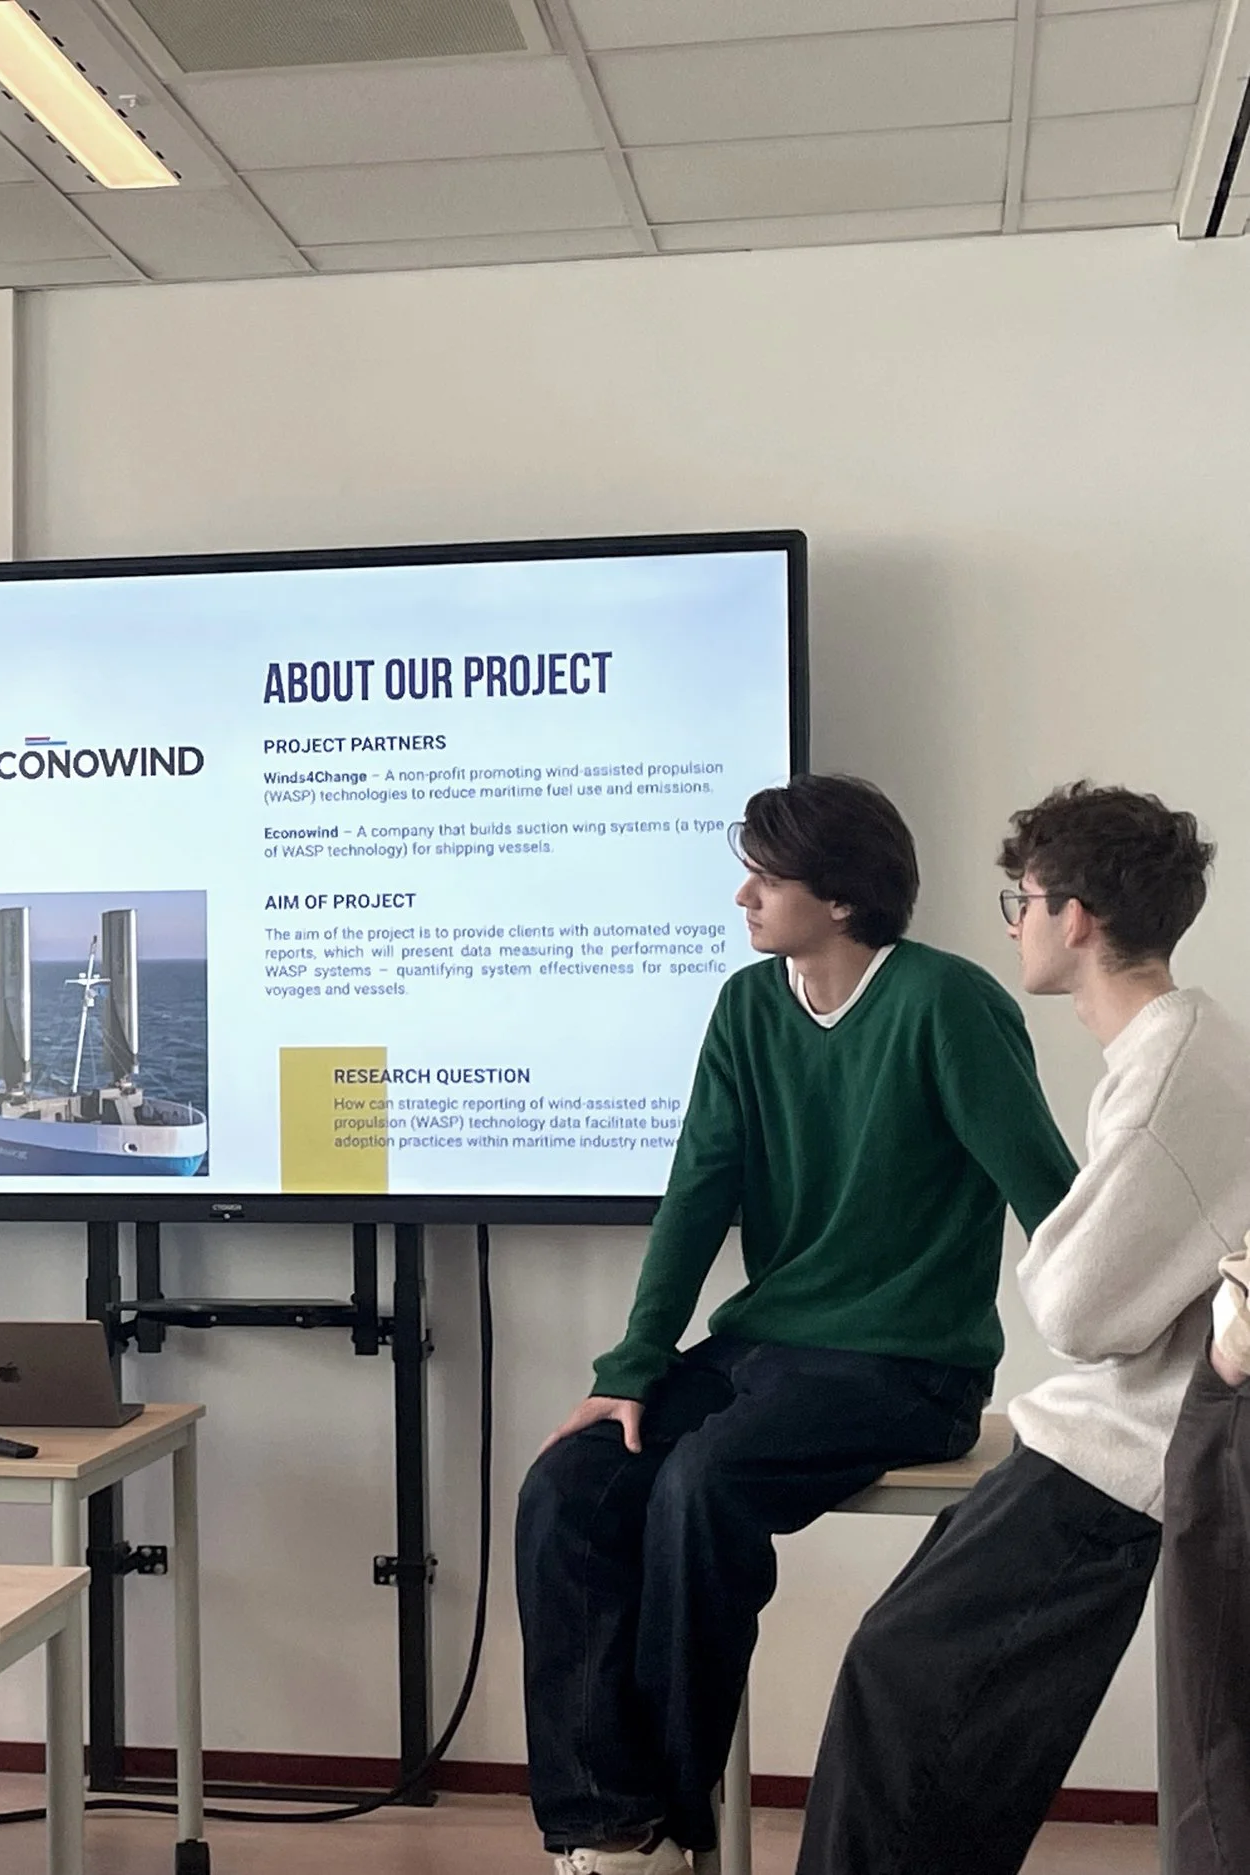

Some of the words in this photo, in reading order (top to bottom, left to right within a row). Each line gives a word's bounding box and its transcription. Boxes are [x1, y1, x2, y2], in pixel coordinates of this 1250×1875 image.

[263, 660, 374, 703] ABOUT
[384, 657, 452, 701] OUR
[463, 651, 614, 697] PROJECT
[264, 737, 346, 754] PROJECT
[351, 735, 447, 752] PARTNERS
[263, 769, 368, 786] Winds4Change
[384, 768, 396, 781] A
[398, 766, 466, 783] non-profit
[469, 764, 542, 781] promoting
[545, 762, 644, 777] wind-assisted
[647, 760, 724, 777] propulsion
[264, 787, 316, 804] (WASP)
[319, 786, 408, 803] technologies
[411, 786, 426, 798] to
[428, 785, 476, 798] reduce
[479, 783, 543, 797] maritime
[546, 783, 573, 796] fuel
[576, 785, 602, 795] use
[606, 781, 633, 795] and
[636, 780, 714, 794] emissions.
[264, 825, 339, 839] Econowind
[356, 824, 368, 837] A
[370, 826, 435, 839] company
[438, 822, 466, 835] that
[516, 820, 569, 834] suction
[572, 819, 607, 835] wing
[609, 818, 671, 835] systems
[675, 817, 689, 833] (a
[693, 817, 725, 833] type
[264, 844, 279, 857] of
[282, 844, 324, 857] WASP
[327, 841, 408, 859] technology)
[411, 842, 432, 855] for
[435, 841, 495, 857] shipping
[498, 840, 555, 853] vessels.
[265, 895, 300, 910] AIM
[305, 894, 328, 909] OF
[333, 893, 416, 909] PROJECT
[264, 927, 291, 940] The
[294, 927, 320, 940] aim
[323, 927, 339, 939] of
[341, 926, 364, 939] the
[367, 926, 416, 941] project
[419, 925, 431, 938] is
[434, 925, 449, 938] to
[452, 925, 505, 940] provide
[508, 924, 555, 937] clients
[558, 924, 589, 936] with
[592, 923, 671, 936] automated
[674, 925, 726, 938] voyage
[264, 945, 317, 961] reports,
[323, 945, 365, 958] which
[370, 945, 394, 957] will
[401, 944, 454, 960] present
[460, 943, 492, 956] data
[499, 942, 574, 959] measuring
[580, 942, 604, 955] the
[610, 941, 703, 957] performance
[710, 941, 726, 953] of
[264, 964, 308, 977] WASP
[313, 963, 372, 979] systems
[396, 962, 474, 978] quantifying
[480, 962, 532, 977] system
[539, 961, 635, 974] effectiveness
[642, 960, 662, 973] for
[669, 960, 727, 976] specific
[265, 985, 321, 998] voyages
[325, 982, 351, 994] and
[353, 981, 409, 994] vessels.
[334, 1069, 431, 1084] RESEARCH
[436, 1068, 531, 1086] QUESTION
[333, 1097, 365, 1109] How
[368, 1100, 394, 1109] can
[397, 1097, 459, 1112] strategic
[462, 1097, 526, 1112] reporting
[529, 1097, 545, 1109] of
[548, 1096, 647, 1109] wind-assisted
[650, 1096, 681, 1112] ship
[333, 1115, 407, 1131] propulsion
[410, 1114, 465, 1131] (WASP)
[468, 1115, 546, 1131] technology
[549, 1115, 581, 1128] data
[585, 1116, 648, 1128] facilitate
[650, 1116, 683, 1128] busi
[333, 1134, 395, 1149] adoption
[398, 1134, 463, 1149] practices
[466, 1134, 507, 1147] within
[511, 1134, 576, 1147] maritime
[579, 1134, 637, 1150] industry
[640, 1134, 678, 1147] netw
